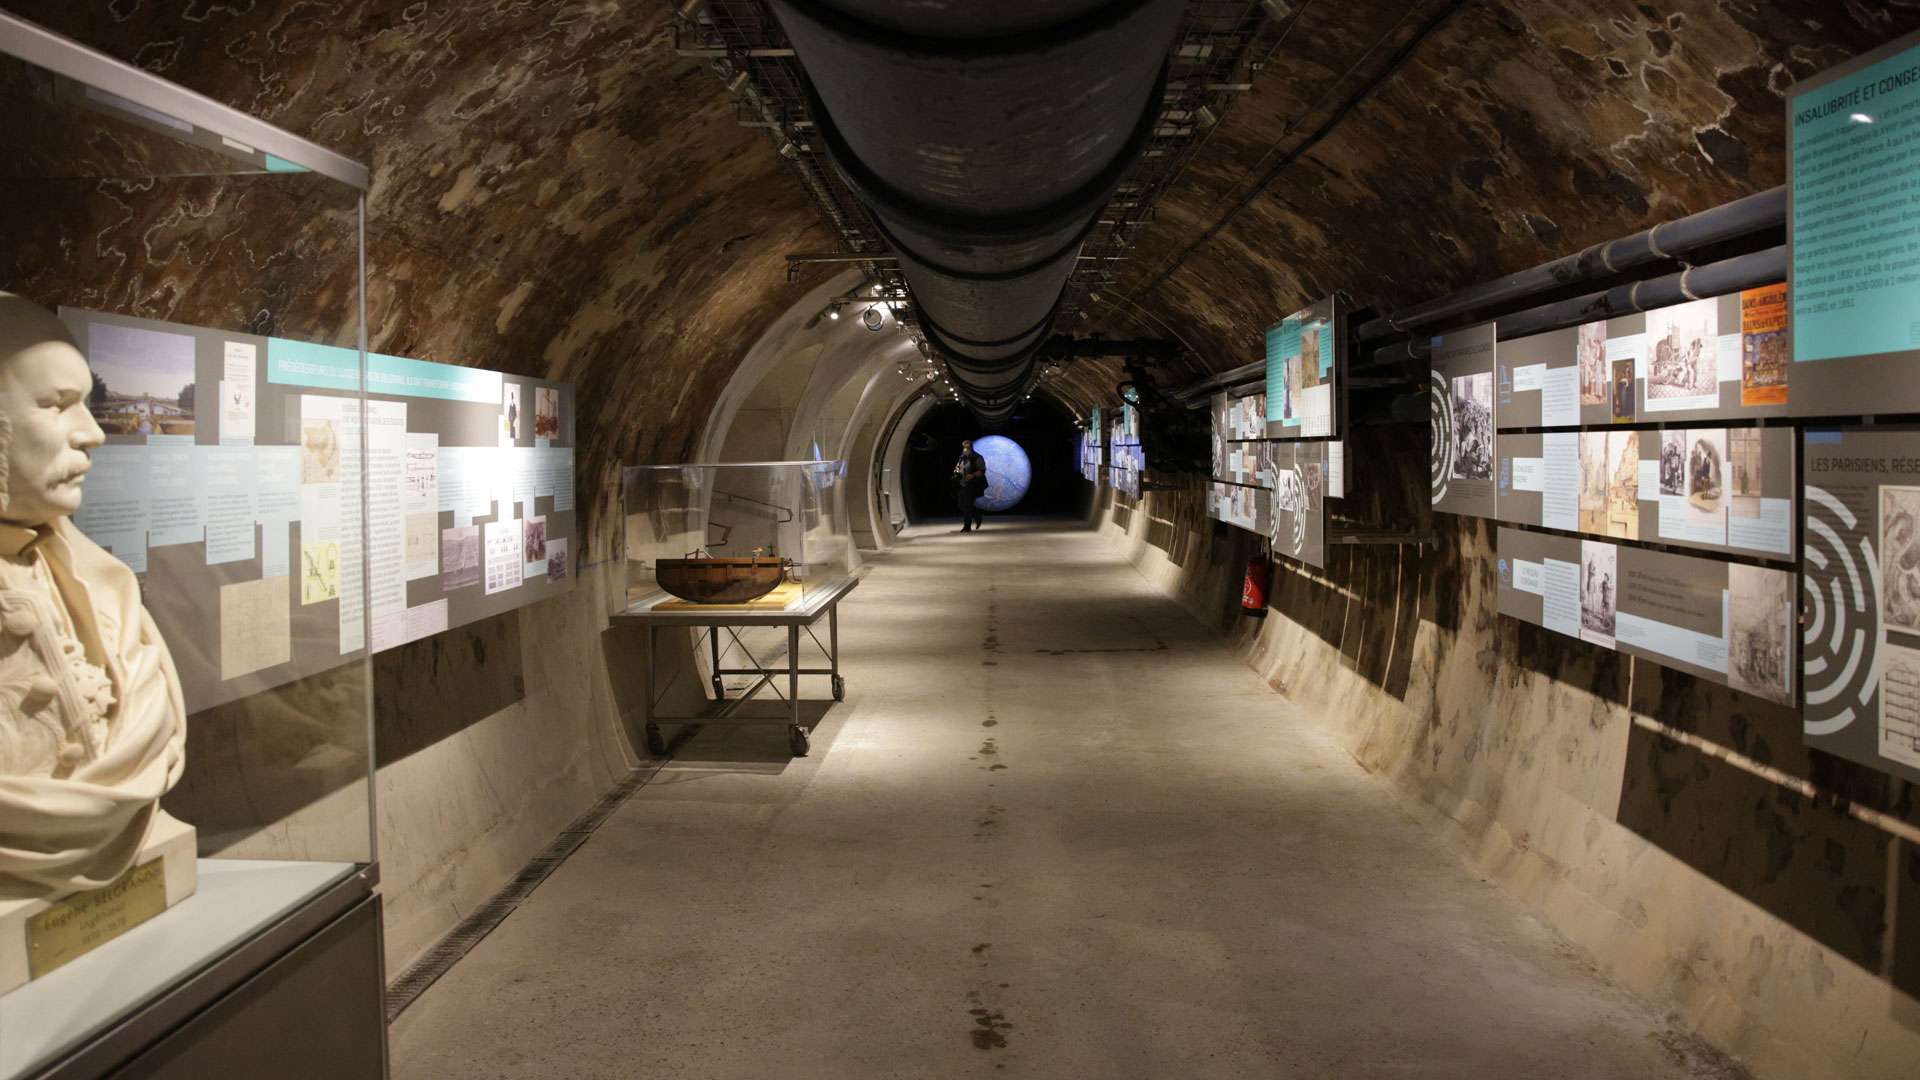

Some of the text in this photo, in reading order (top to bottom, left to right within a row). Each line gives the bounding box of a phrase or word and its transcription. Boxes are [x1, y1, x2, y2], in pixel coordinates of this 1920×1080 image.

[1795, 88, 1861, 127] INSALUBRITÉ
[1863, 83, 1877, 101] ET
[1810, 457, 1829, 473] LES
[1831, 457, 1889, 474] PARISIENS,
